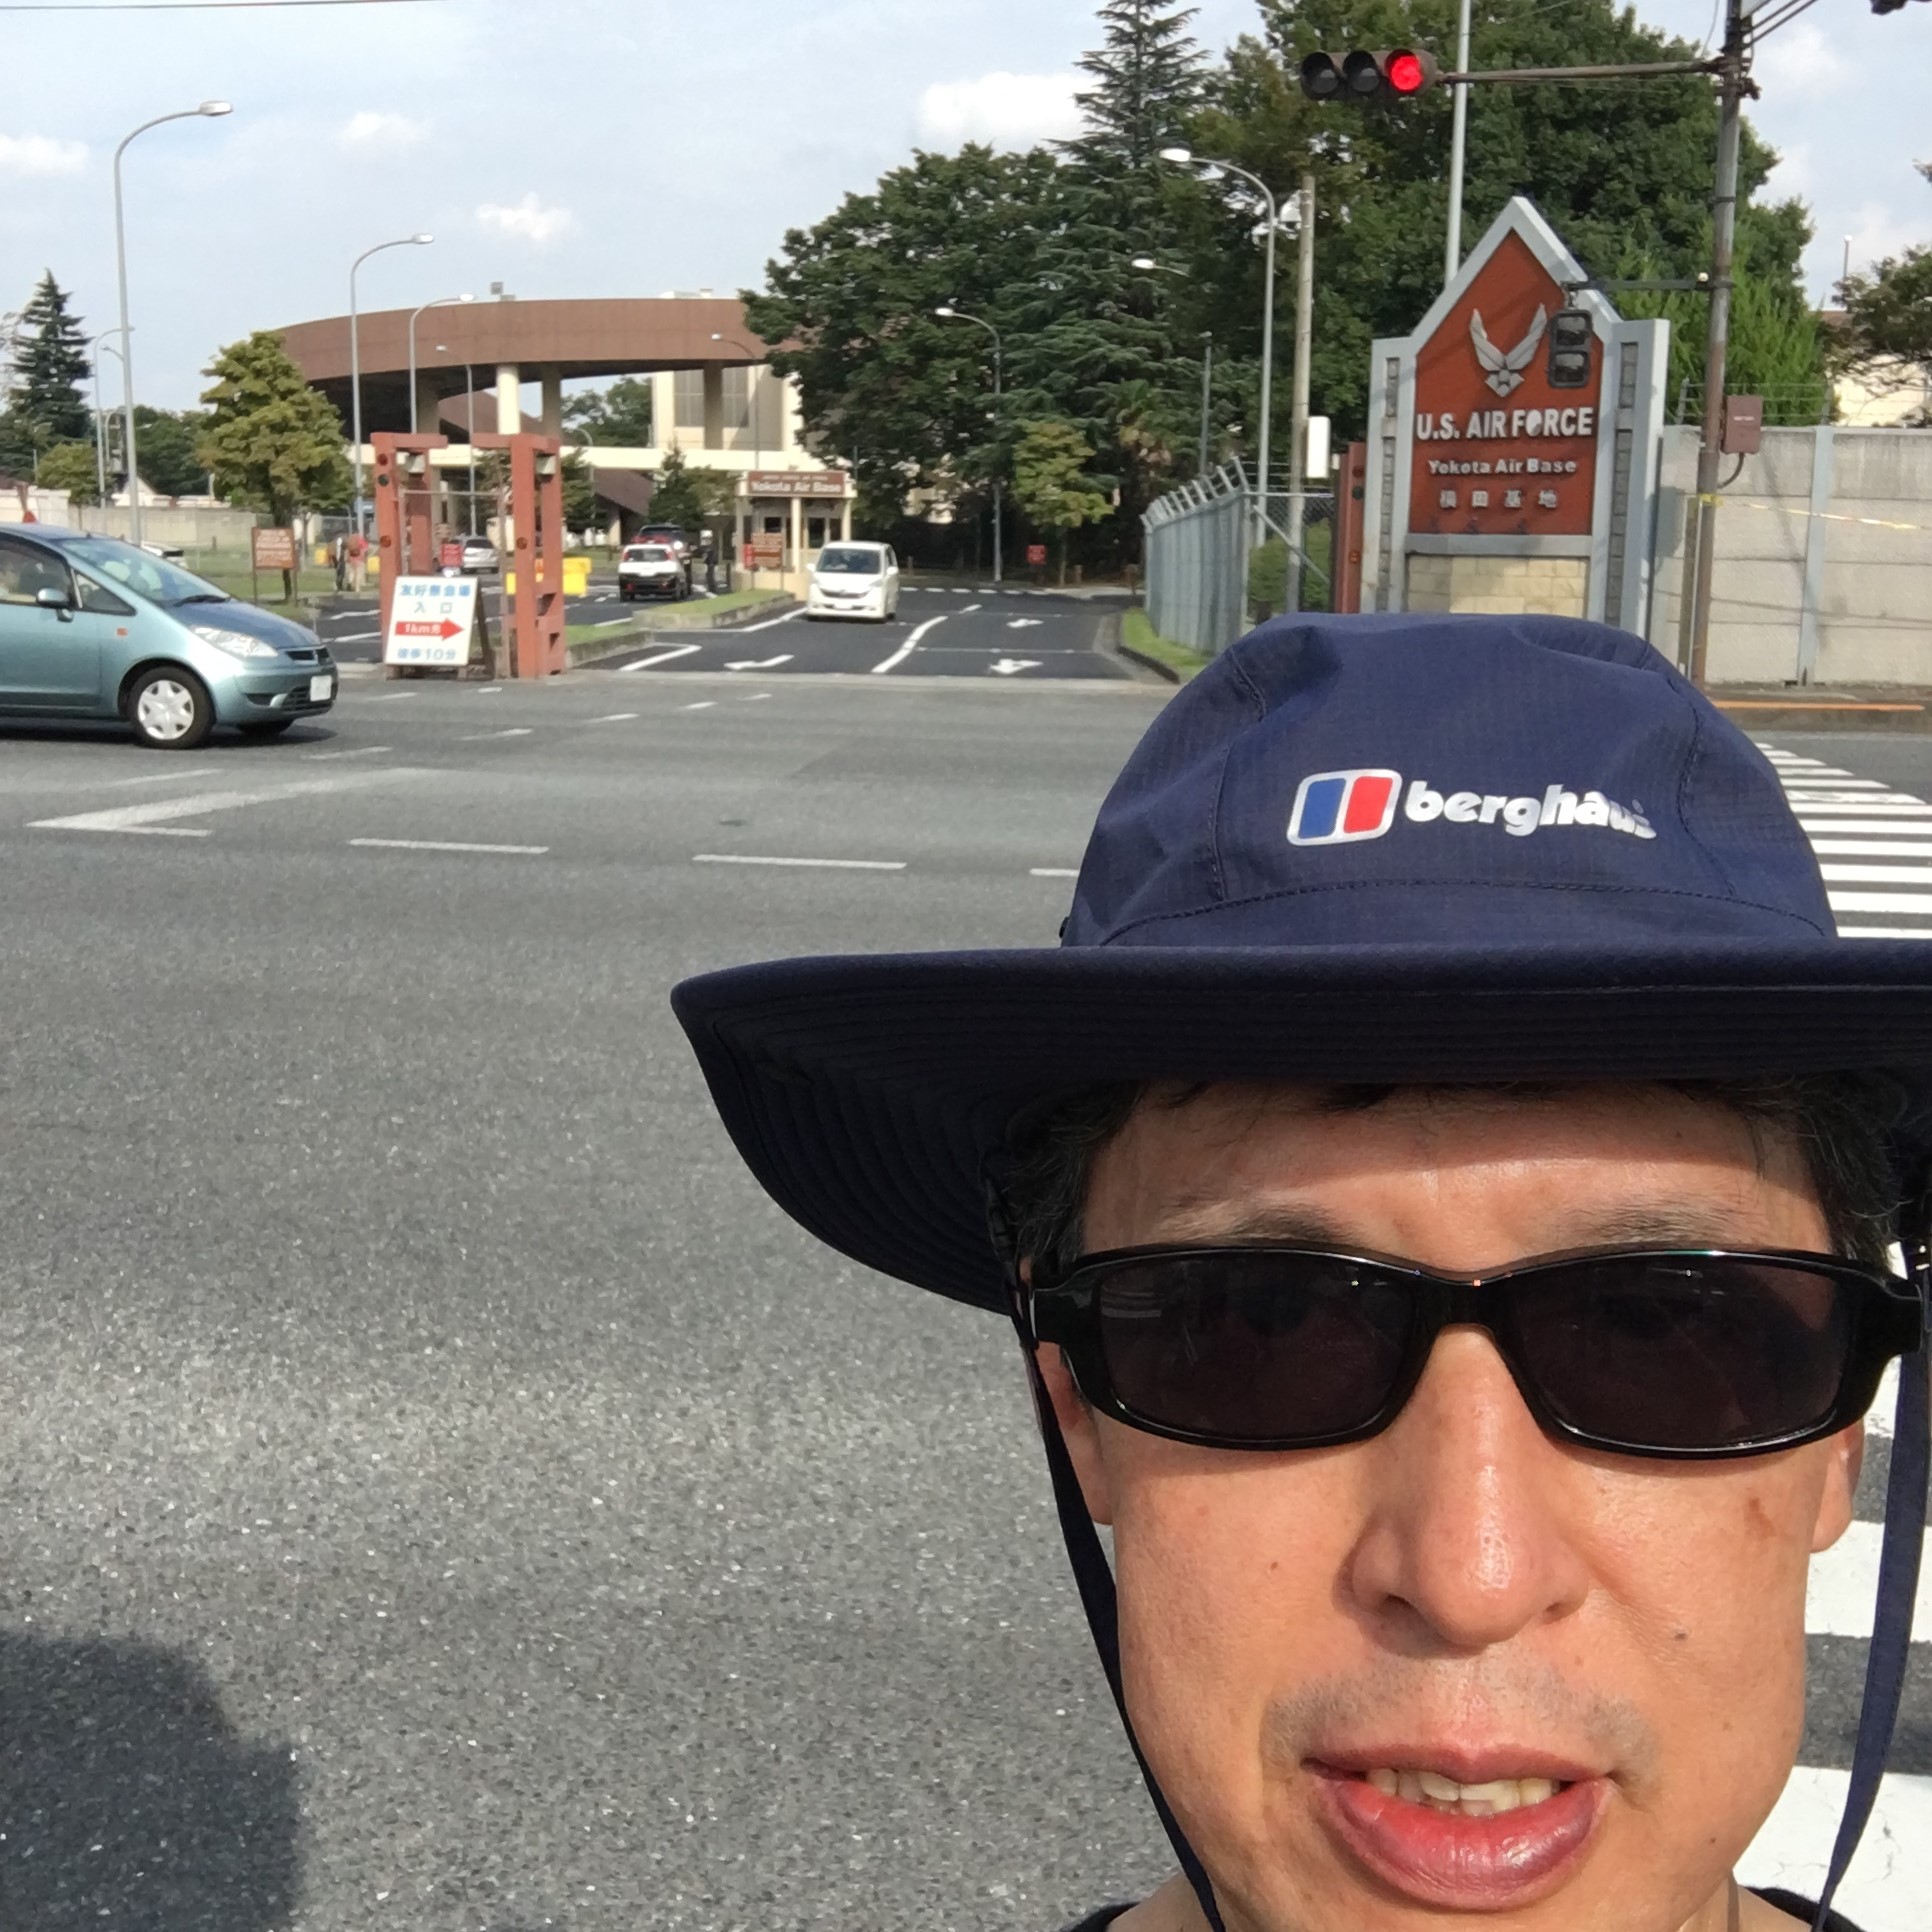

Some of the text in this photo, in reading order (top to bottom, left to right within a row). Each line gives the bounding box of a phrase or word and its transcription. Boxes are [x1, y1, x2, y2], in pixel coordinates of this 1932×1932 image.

[1416, 407, 1594, 440] U.S. AIR FORCE
[1428, 458, 1577, 474] Yokota Air Base
